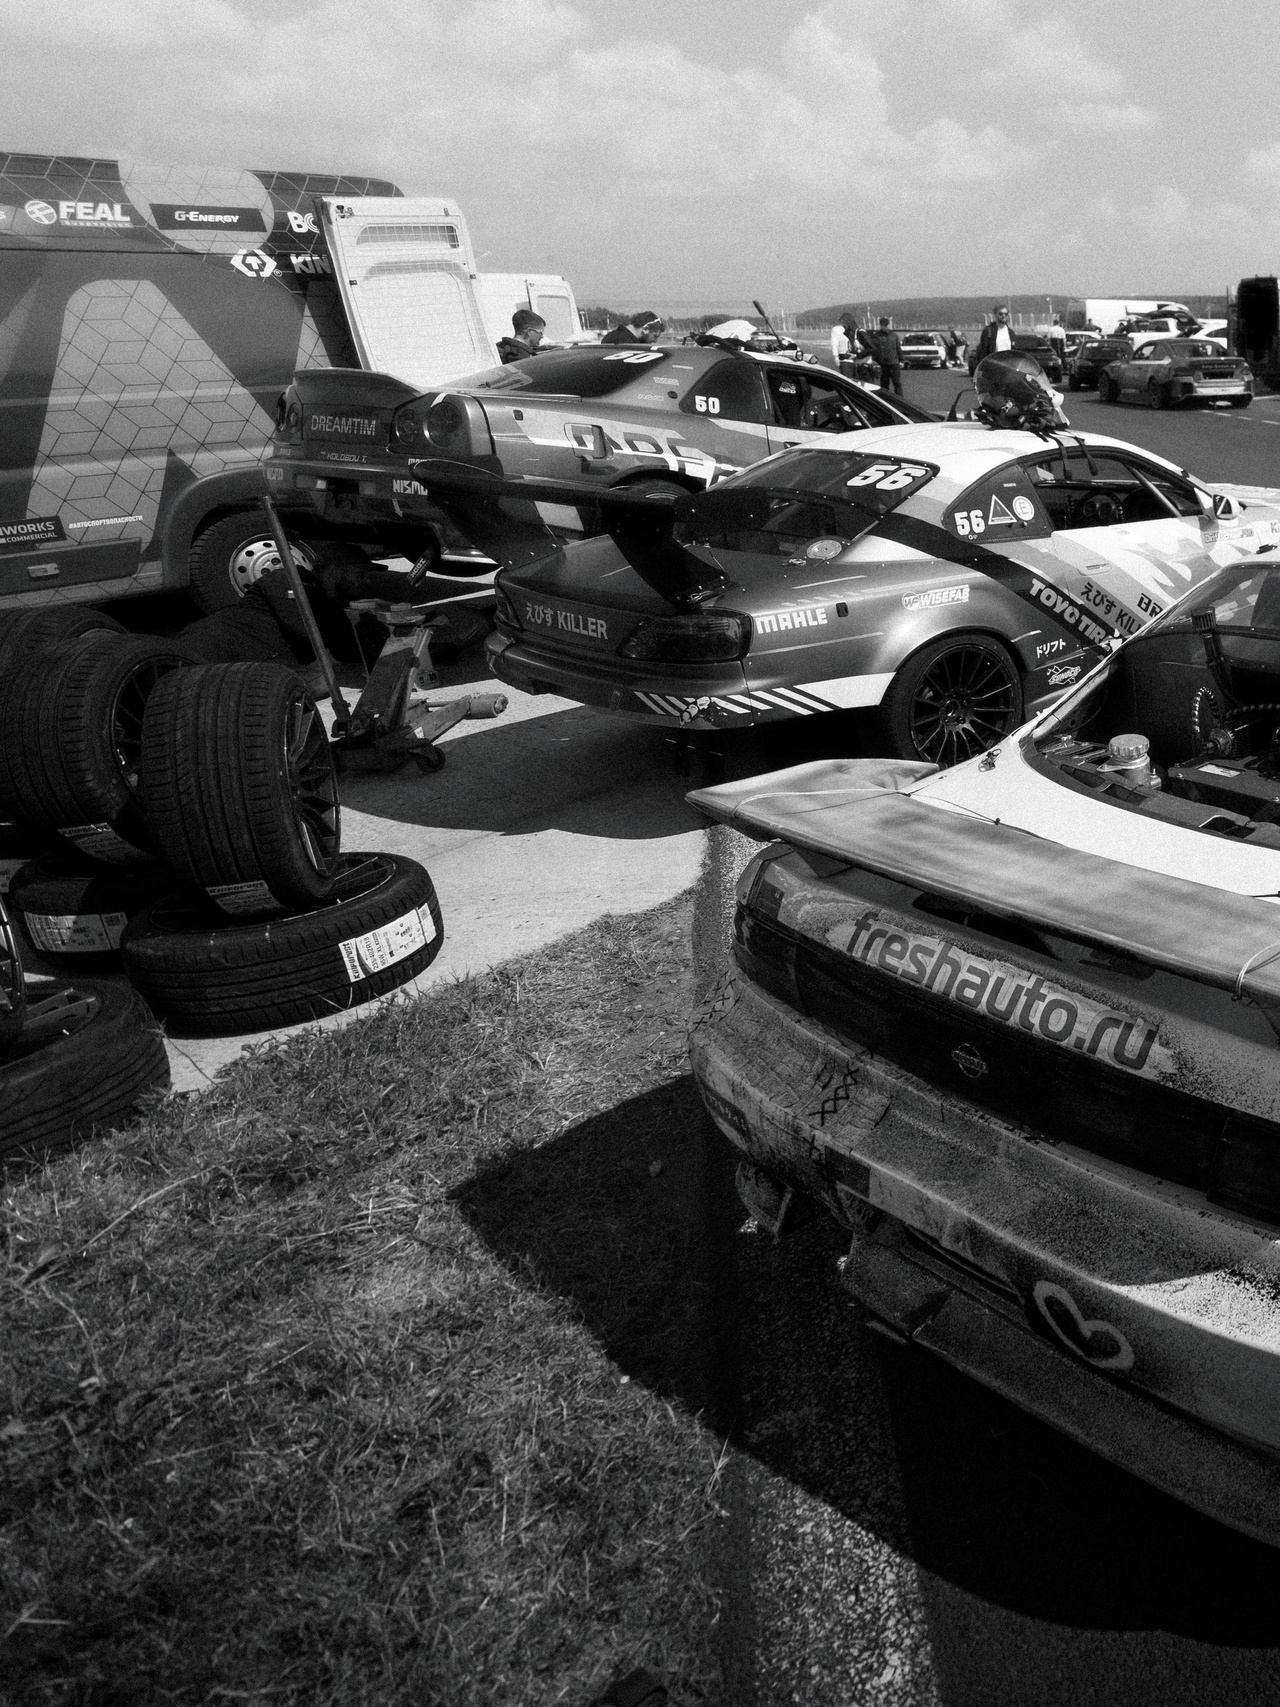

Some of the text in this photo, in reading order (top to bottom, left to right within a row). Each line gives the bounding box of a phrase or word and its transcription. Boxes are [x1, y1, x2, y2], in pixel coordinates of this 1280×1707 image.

[59, 200, 131, 221] FEAL
[290, 254, 331, 274] KIN
[694, 395, 720, 414] 50
[846, 464, 927, 491] 56
[0, 521, 55, 537] WORKS
[953, 509, 986, 536] 56
[6, 531, 58, 543] COMMERCIAL
[920, 586, 970, 608] WISEFAB
[1081, 582, 1117, 615] えびす
[526, 601, 609, 640] えびす KILLER
[755, 607, 829, 635] MAHLE
[1029, 578, 1111, 651] TOYO TIR
[1036, 638, 1067, 659] ドリフト
[846, 911, 1160, 1071] freshauto.ru
